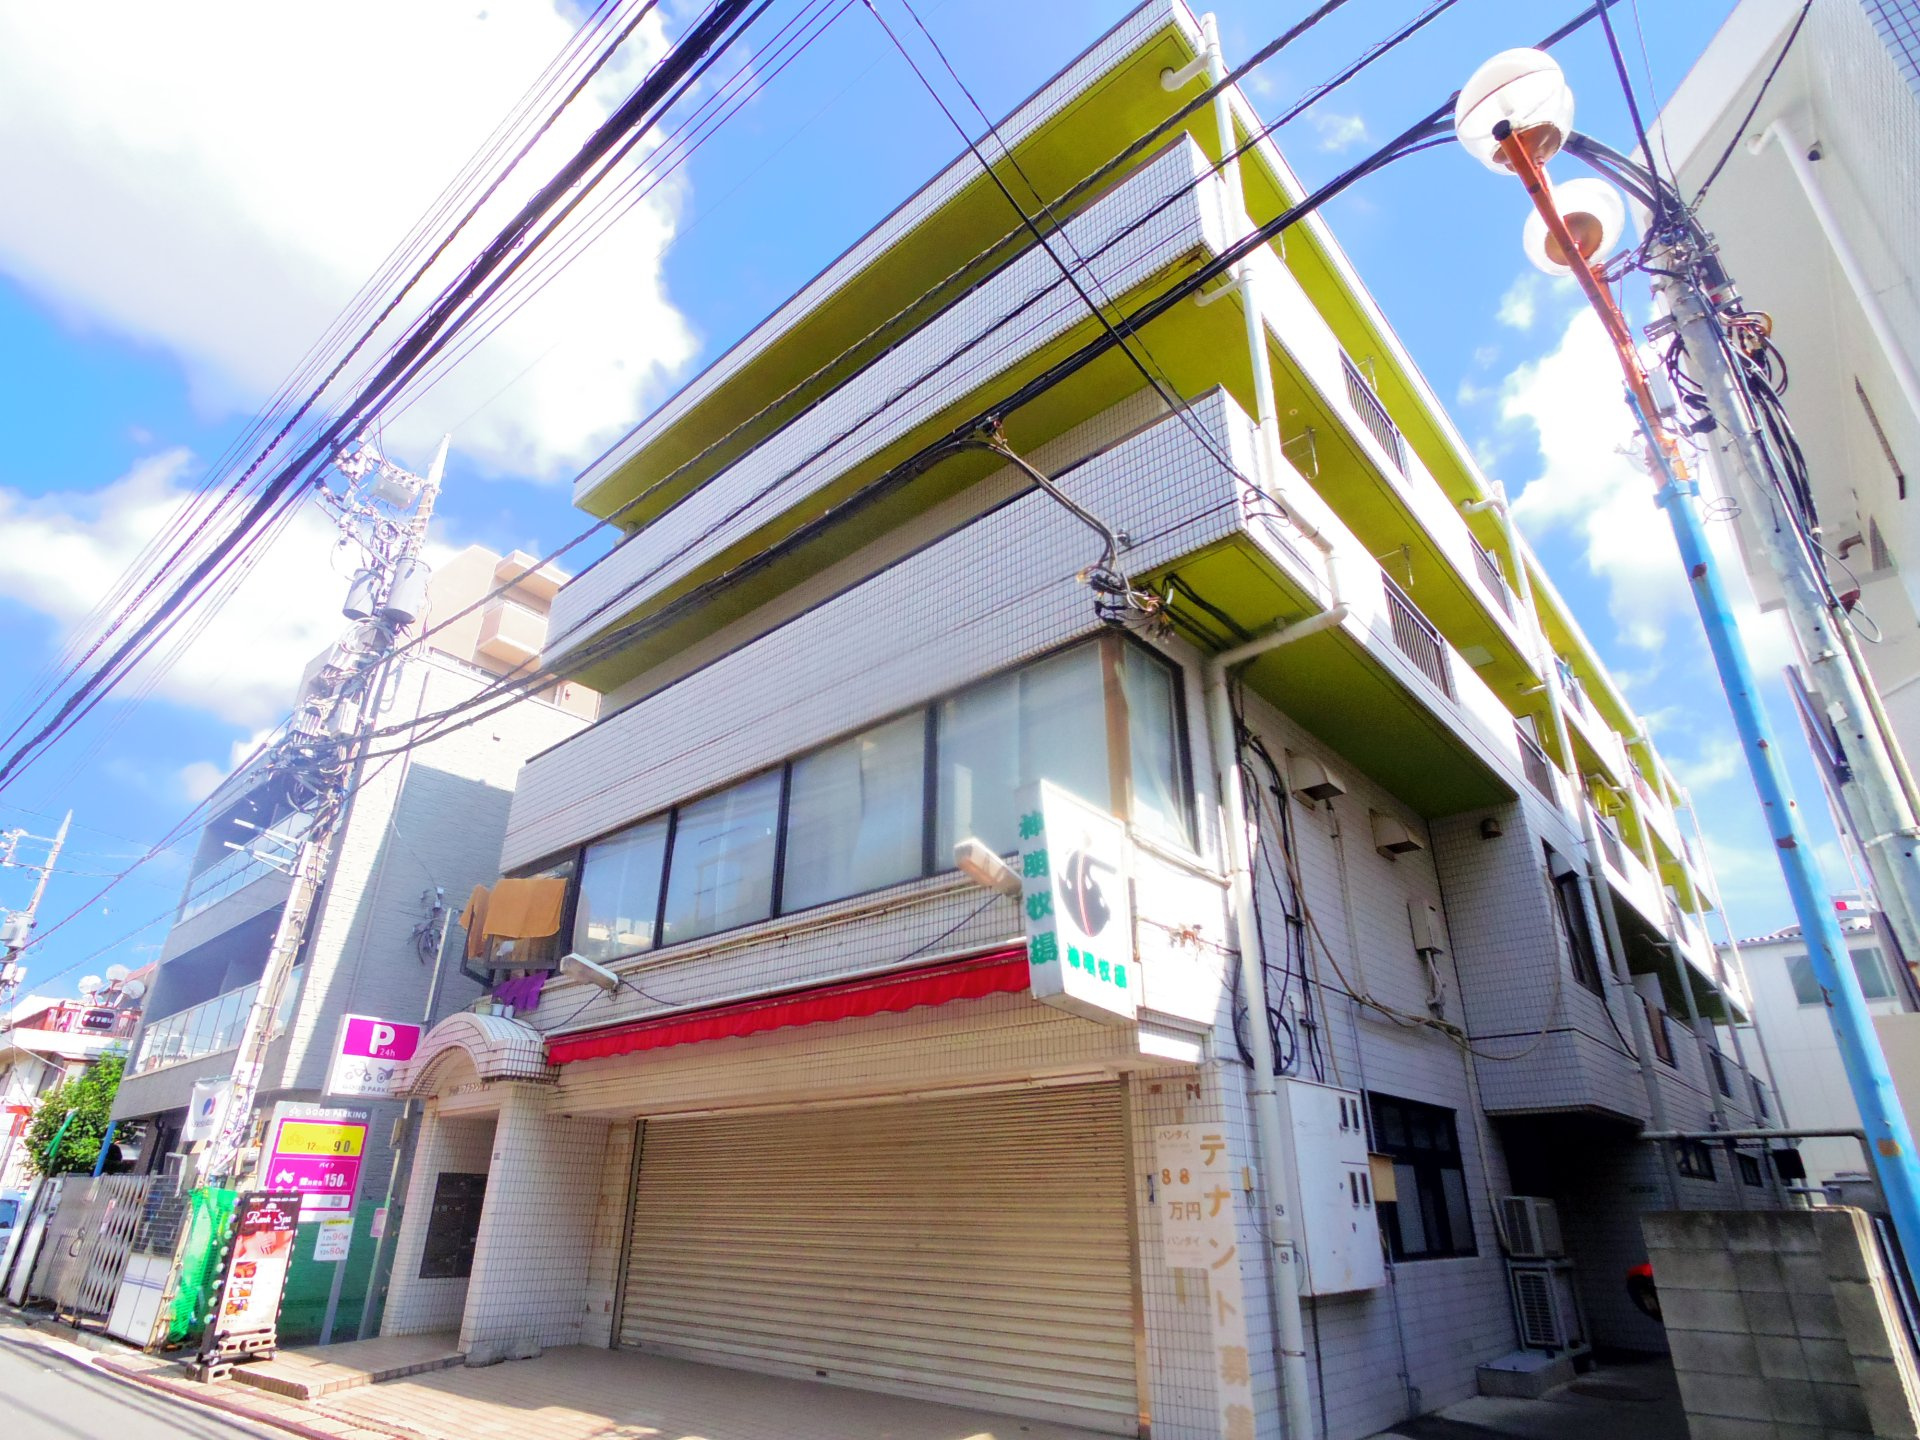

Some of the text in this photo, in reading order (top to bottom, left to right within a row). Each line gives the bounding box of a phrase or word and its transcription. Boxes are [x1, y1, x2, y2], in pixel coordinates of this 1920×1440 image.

[369, 1023, 396, 1055] P
[380, 1048, 396, 1057] 24h
[305, 1107, 368, 1119] GOOD PARKING
[1167, 1200, 1202, 1221] 万円
